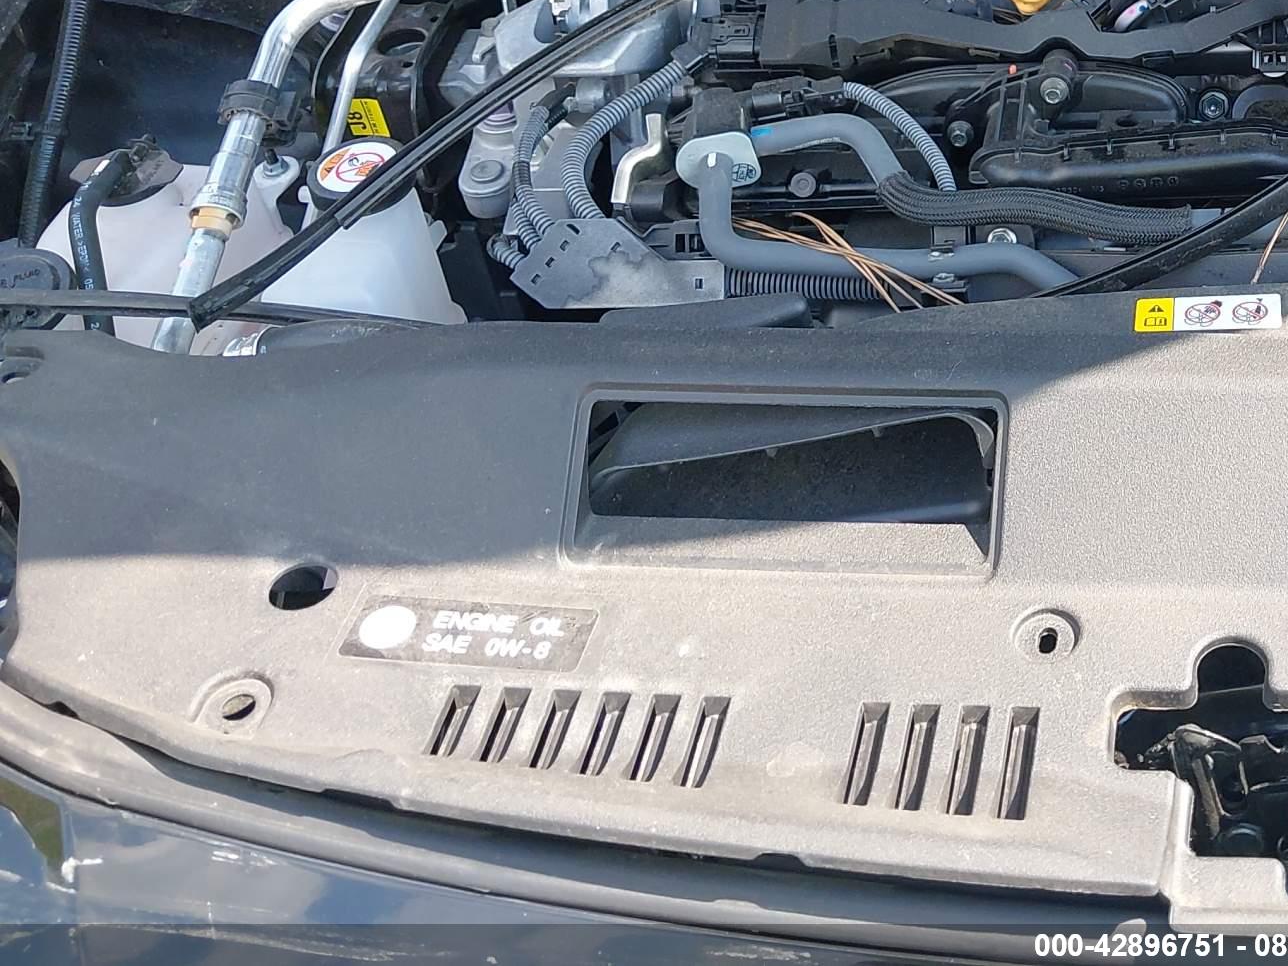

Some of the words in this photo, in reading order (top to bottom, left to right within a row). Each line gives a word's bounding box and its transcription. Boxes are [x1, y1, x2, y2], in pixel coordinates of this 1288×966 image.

[71, 211, 84, 240] WATER
[432, 610, 518, 634] ENGINE
[529, 617, 565, 637] OIL
[422, 633, 472, 654] SAE
